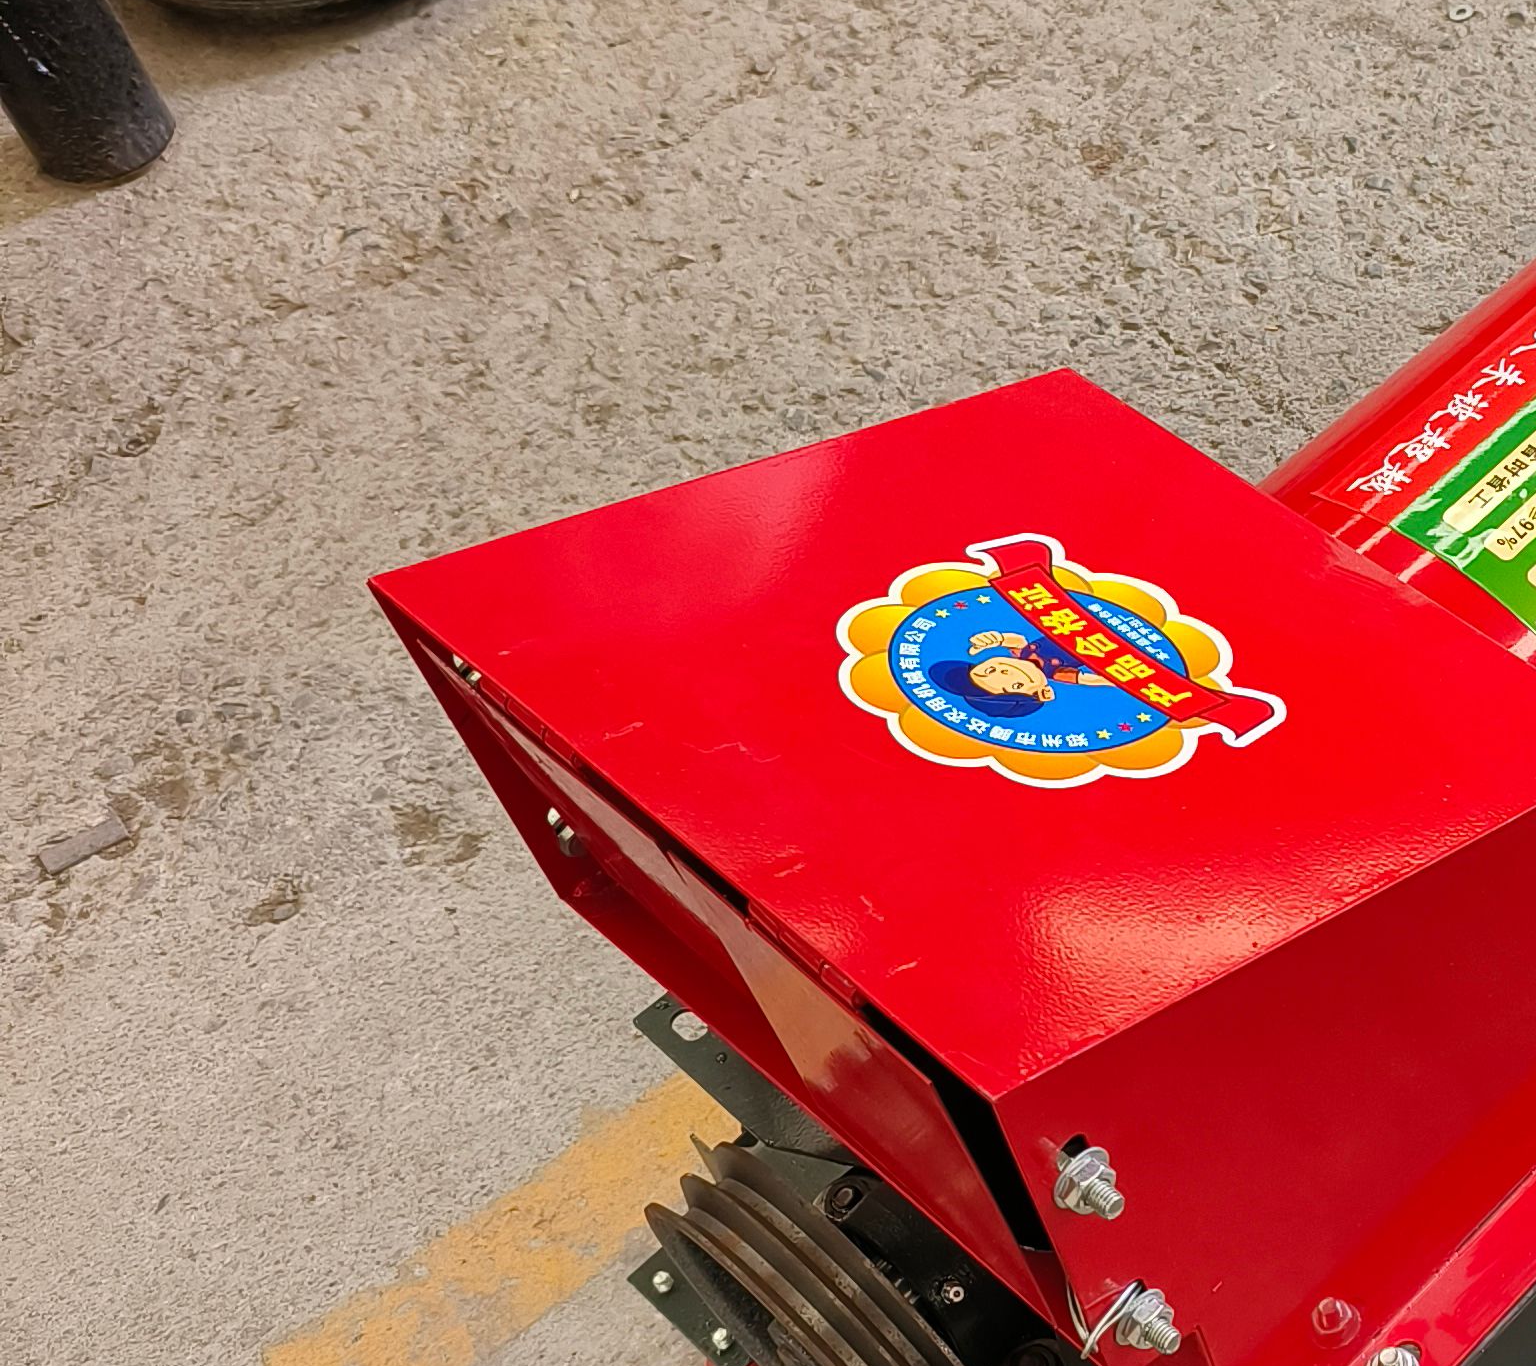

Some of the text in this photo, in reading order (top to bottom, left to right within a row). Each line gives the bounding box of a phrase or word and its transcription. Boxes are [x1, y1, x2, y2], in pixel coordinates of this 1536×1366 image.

[899, 616, 1089, 748] 郑州市腾达农用机械有限公司
[1007, 582, 1192, 707] 产品合格证
